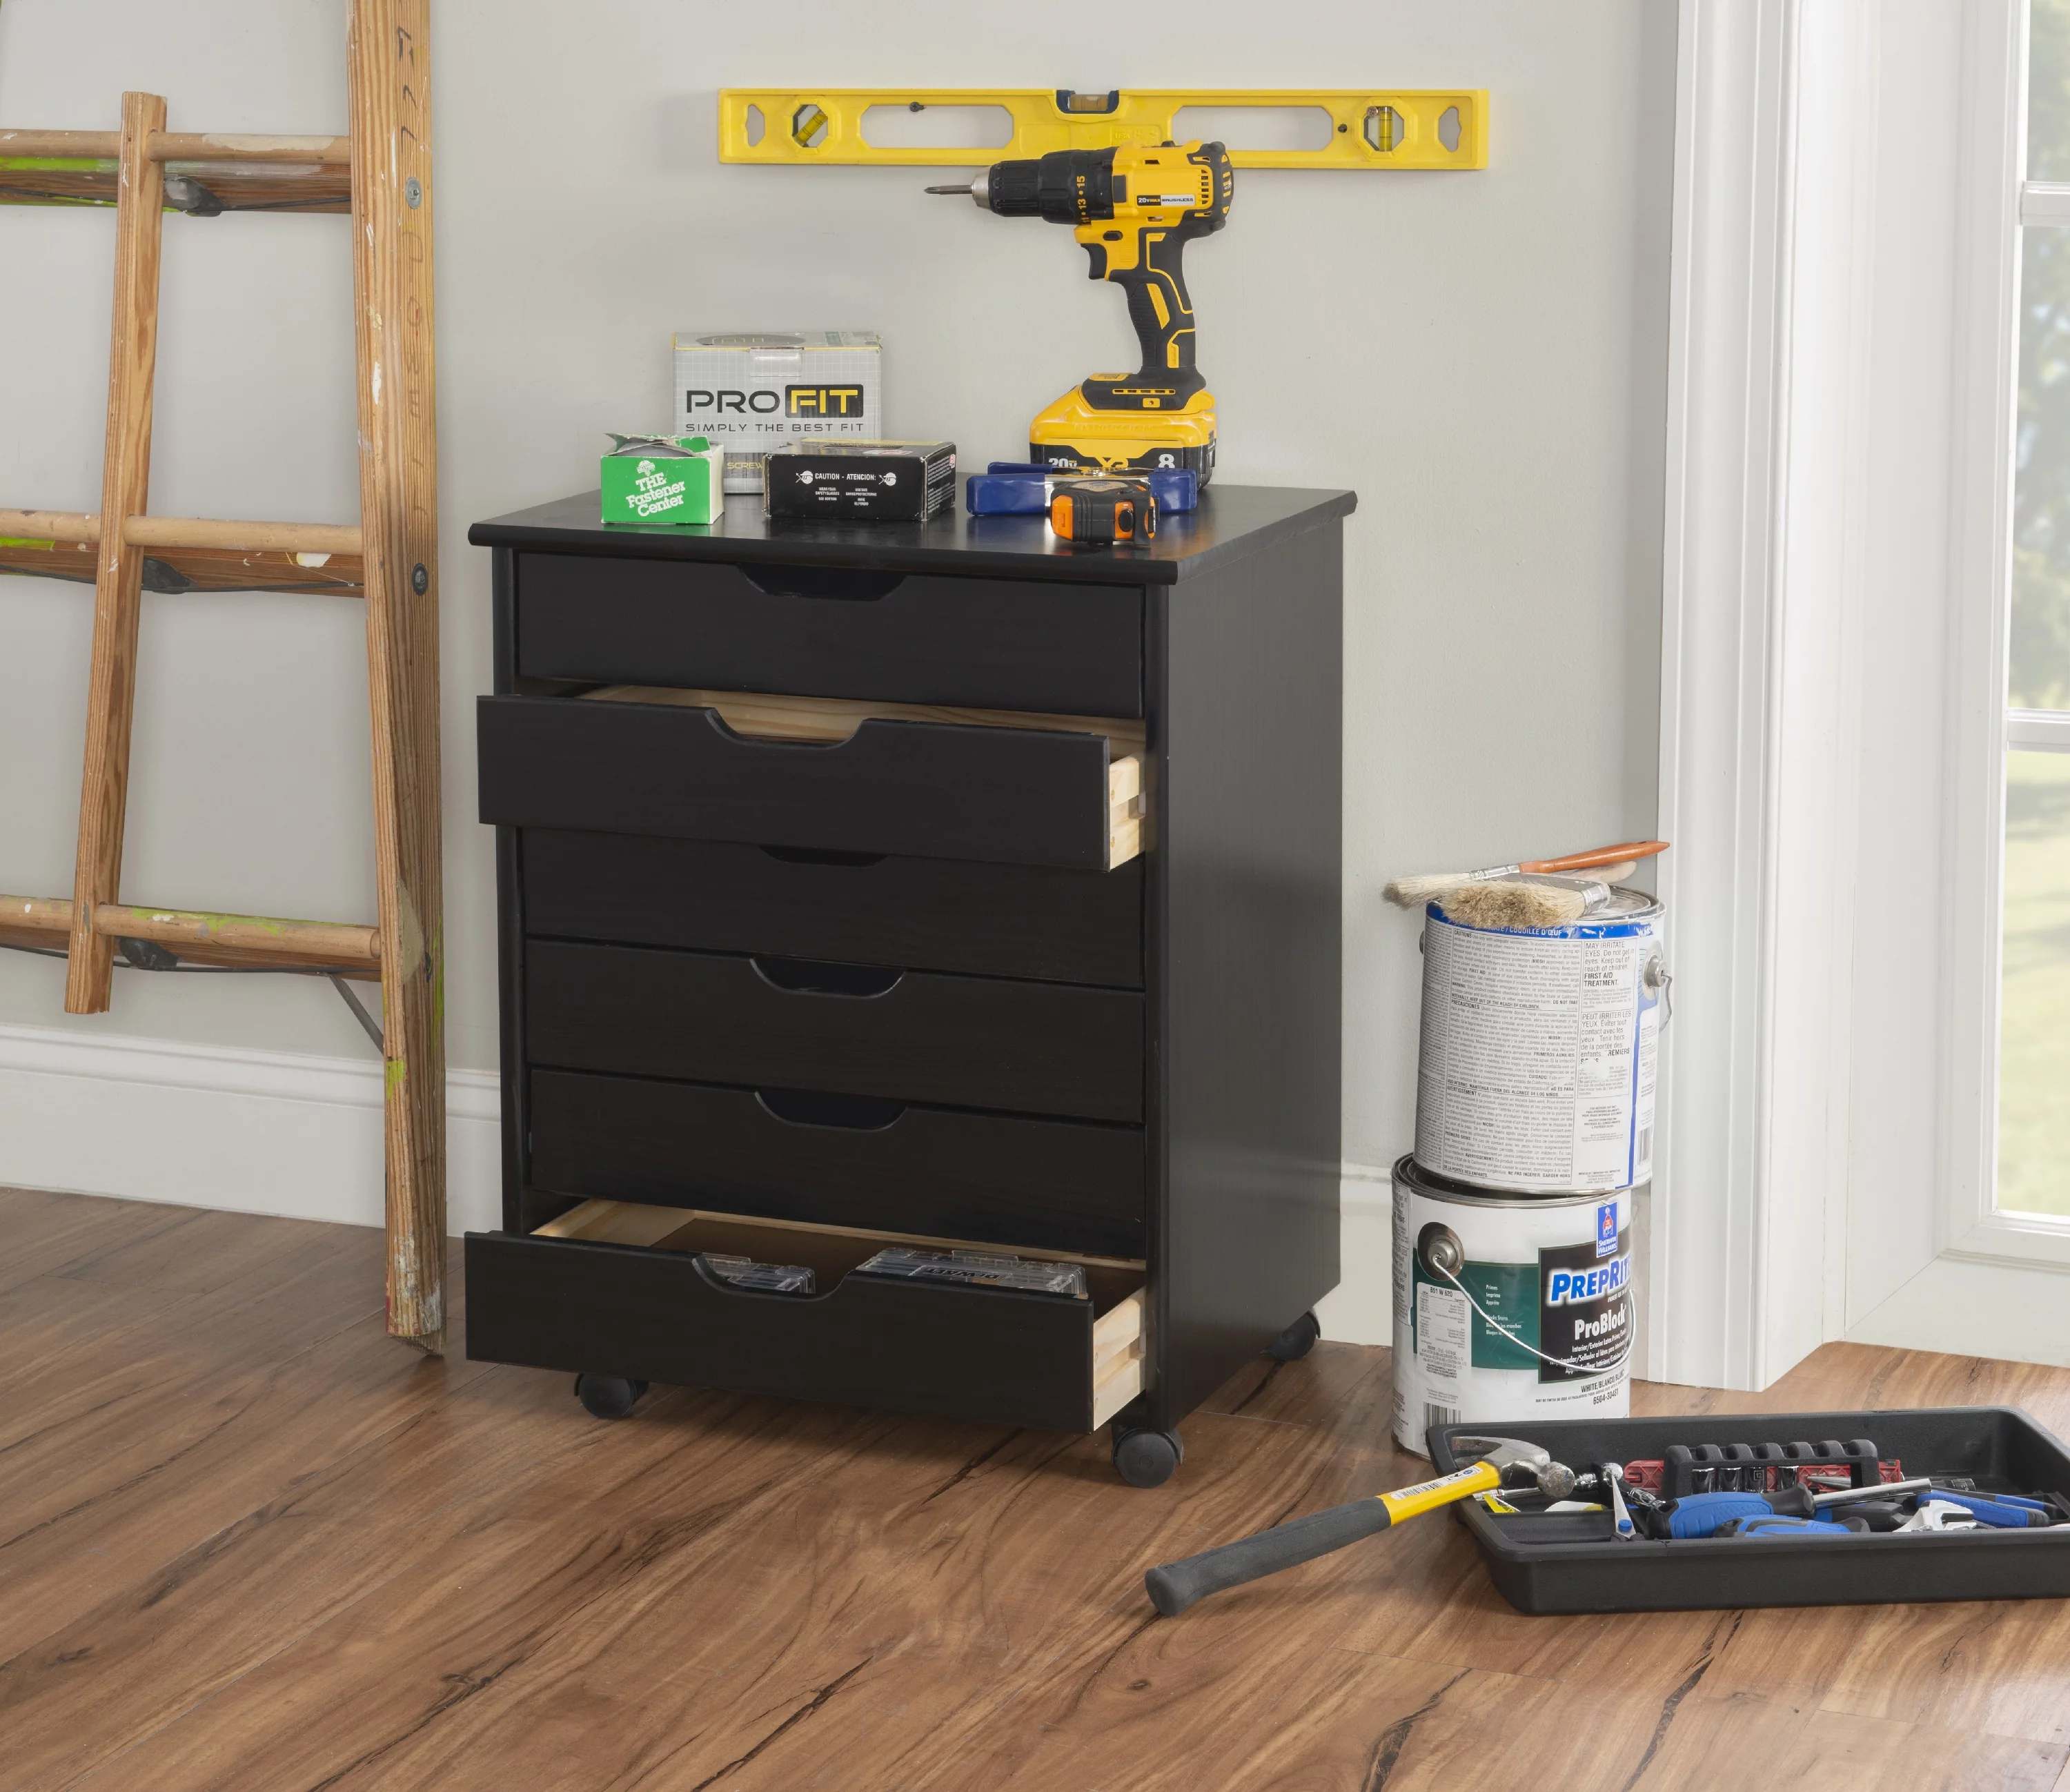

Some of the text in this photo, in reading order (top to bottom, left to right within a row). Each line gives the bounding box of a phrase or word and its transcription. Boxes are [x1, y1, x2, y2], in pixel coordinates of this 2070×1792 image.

[1077, 175, 1085, 188] 15
[1078, 199, 1086, 208] 13
[686, 424, 747, 432] SIMPLY
[756, 424, 783, 432] THE
[792, 424, 833, 432] BEST
[635, 472, 667, 491] THE
[626, 481, 686, 508] Fastener
[638, 494, 684, 516] Center
[1452, 999, 1479, 1009] PRECAUCIONES
[1596, 1043, 1612, 1051] portée
[1448, 1085, 1477, 1096] AVERTISSEMENT
[1599, 1237, 1616, 1245] SHERWIN
[1598, 1243, 1617, 1254] WILLIAMS
[1551, 1254, 1630, 1301] PREPRIT
[1575, 1303, 1626, 1340] ProBlock
[1572, 1341, 1603, 1352] Interior/Exterior
